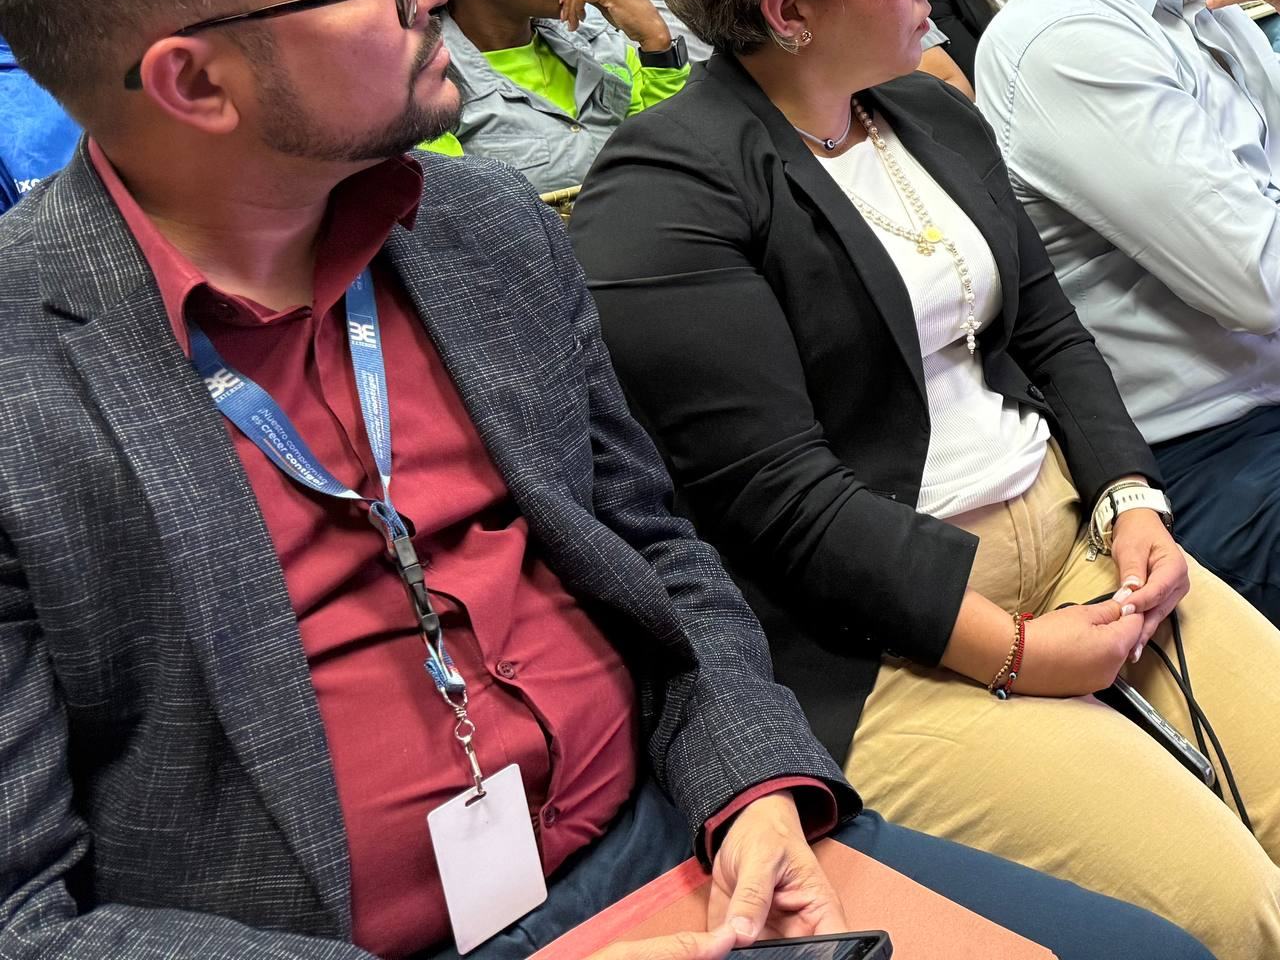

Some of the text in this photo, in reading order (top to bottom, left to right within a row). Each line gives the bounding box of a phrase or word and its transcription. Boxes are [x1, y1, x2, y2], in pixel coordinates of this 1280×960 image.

[251, 415, 327, 486] es crecer contigo!
